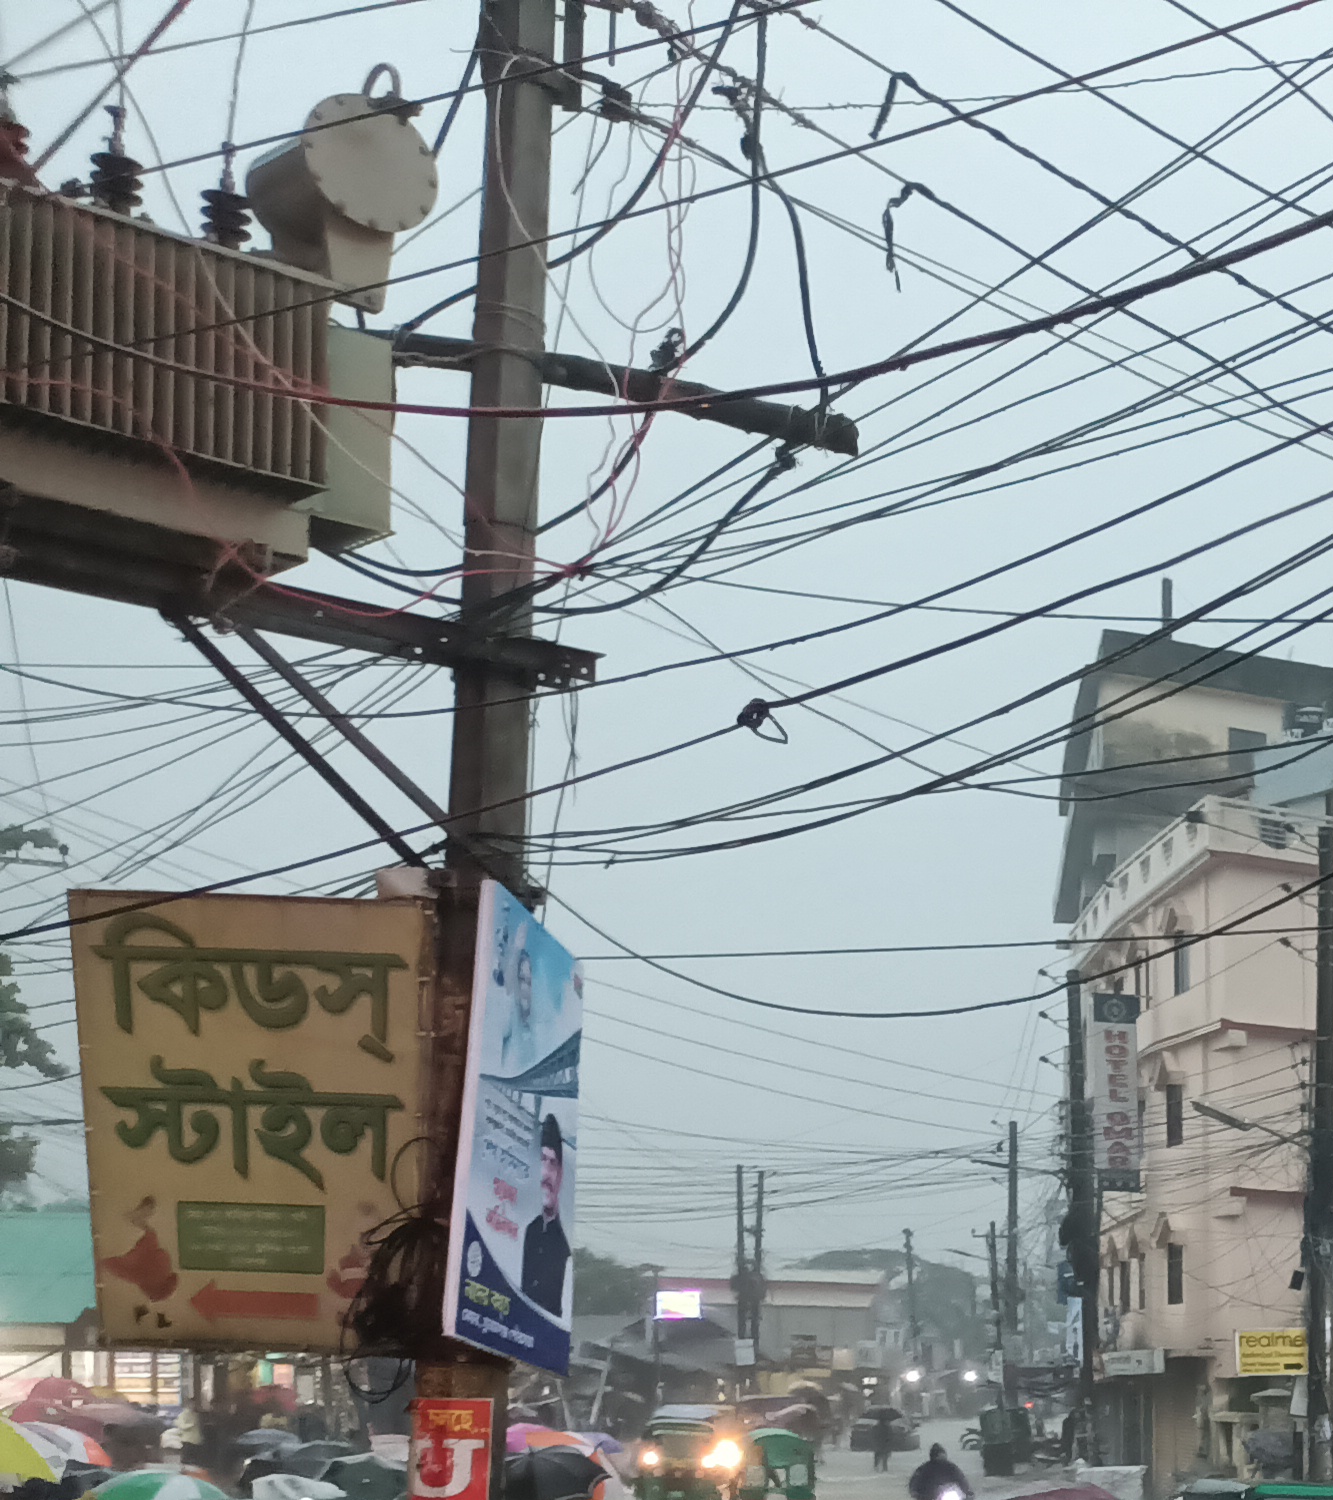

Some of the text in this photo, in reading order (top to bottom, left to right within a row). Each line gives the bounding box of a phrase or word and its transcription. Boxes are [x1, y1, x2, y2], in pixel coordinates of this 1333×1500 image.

[89, 912, 409, 1063] কিডস্
[1104, 1029, 1129, 1102] HOTEL
[99, 1054, 405, 1193] স্টাইল
[1240, 1332, 1305, 1348] realme
